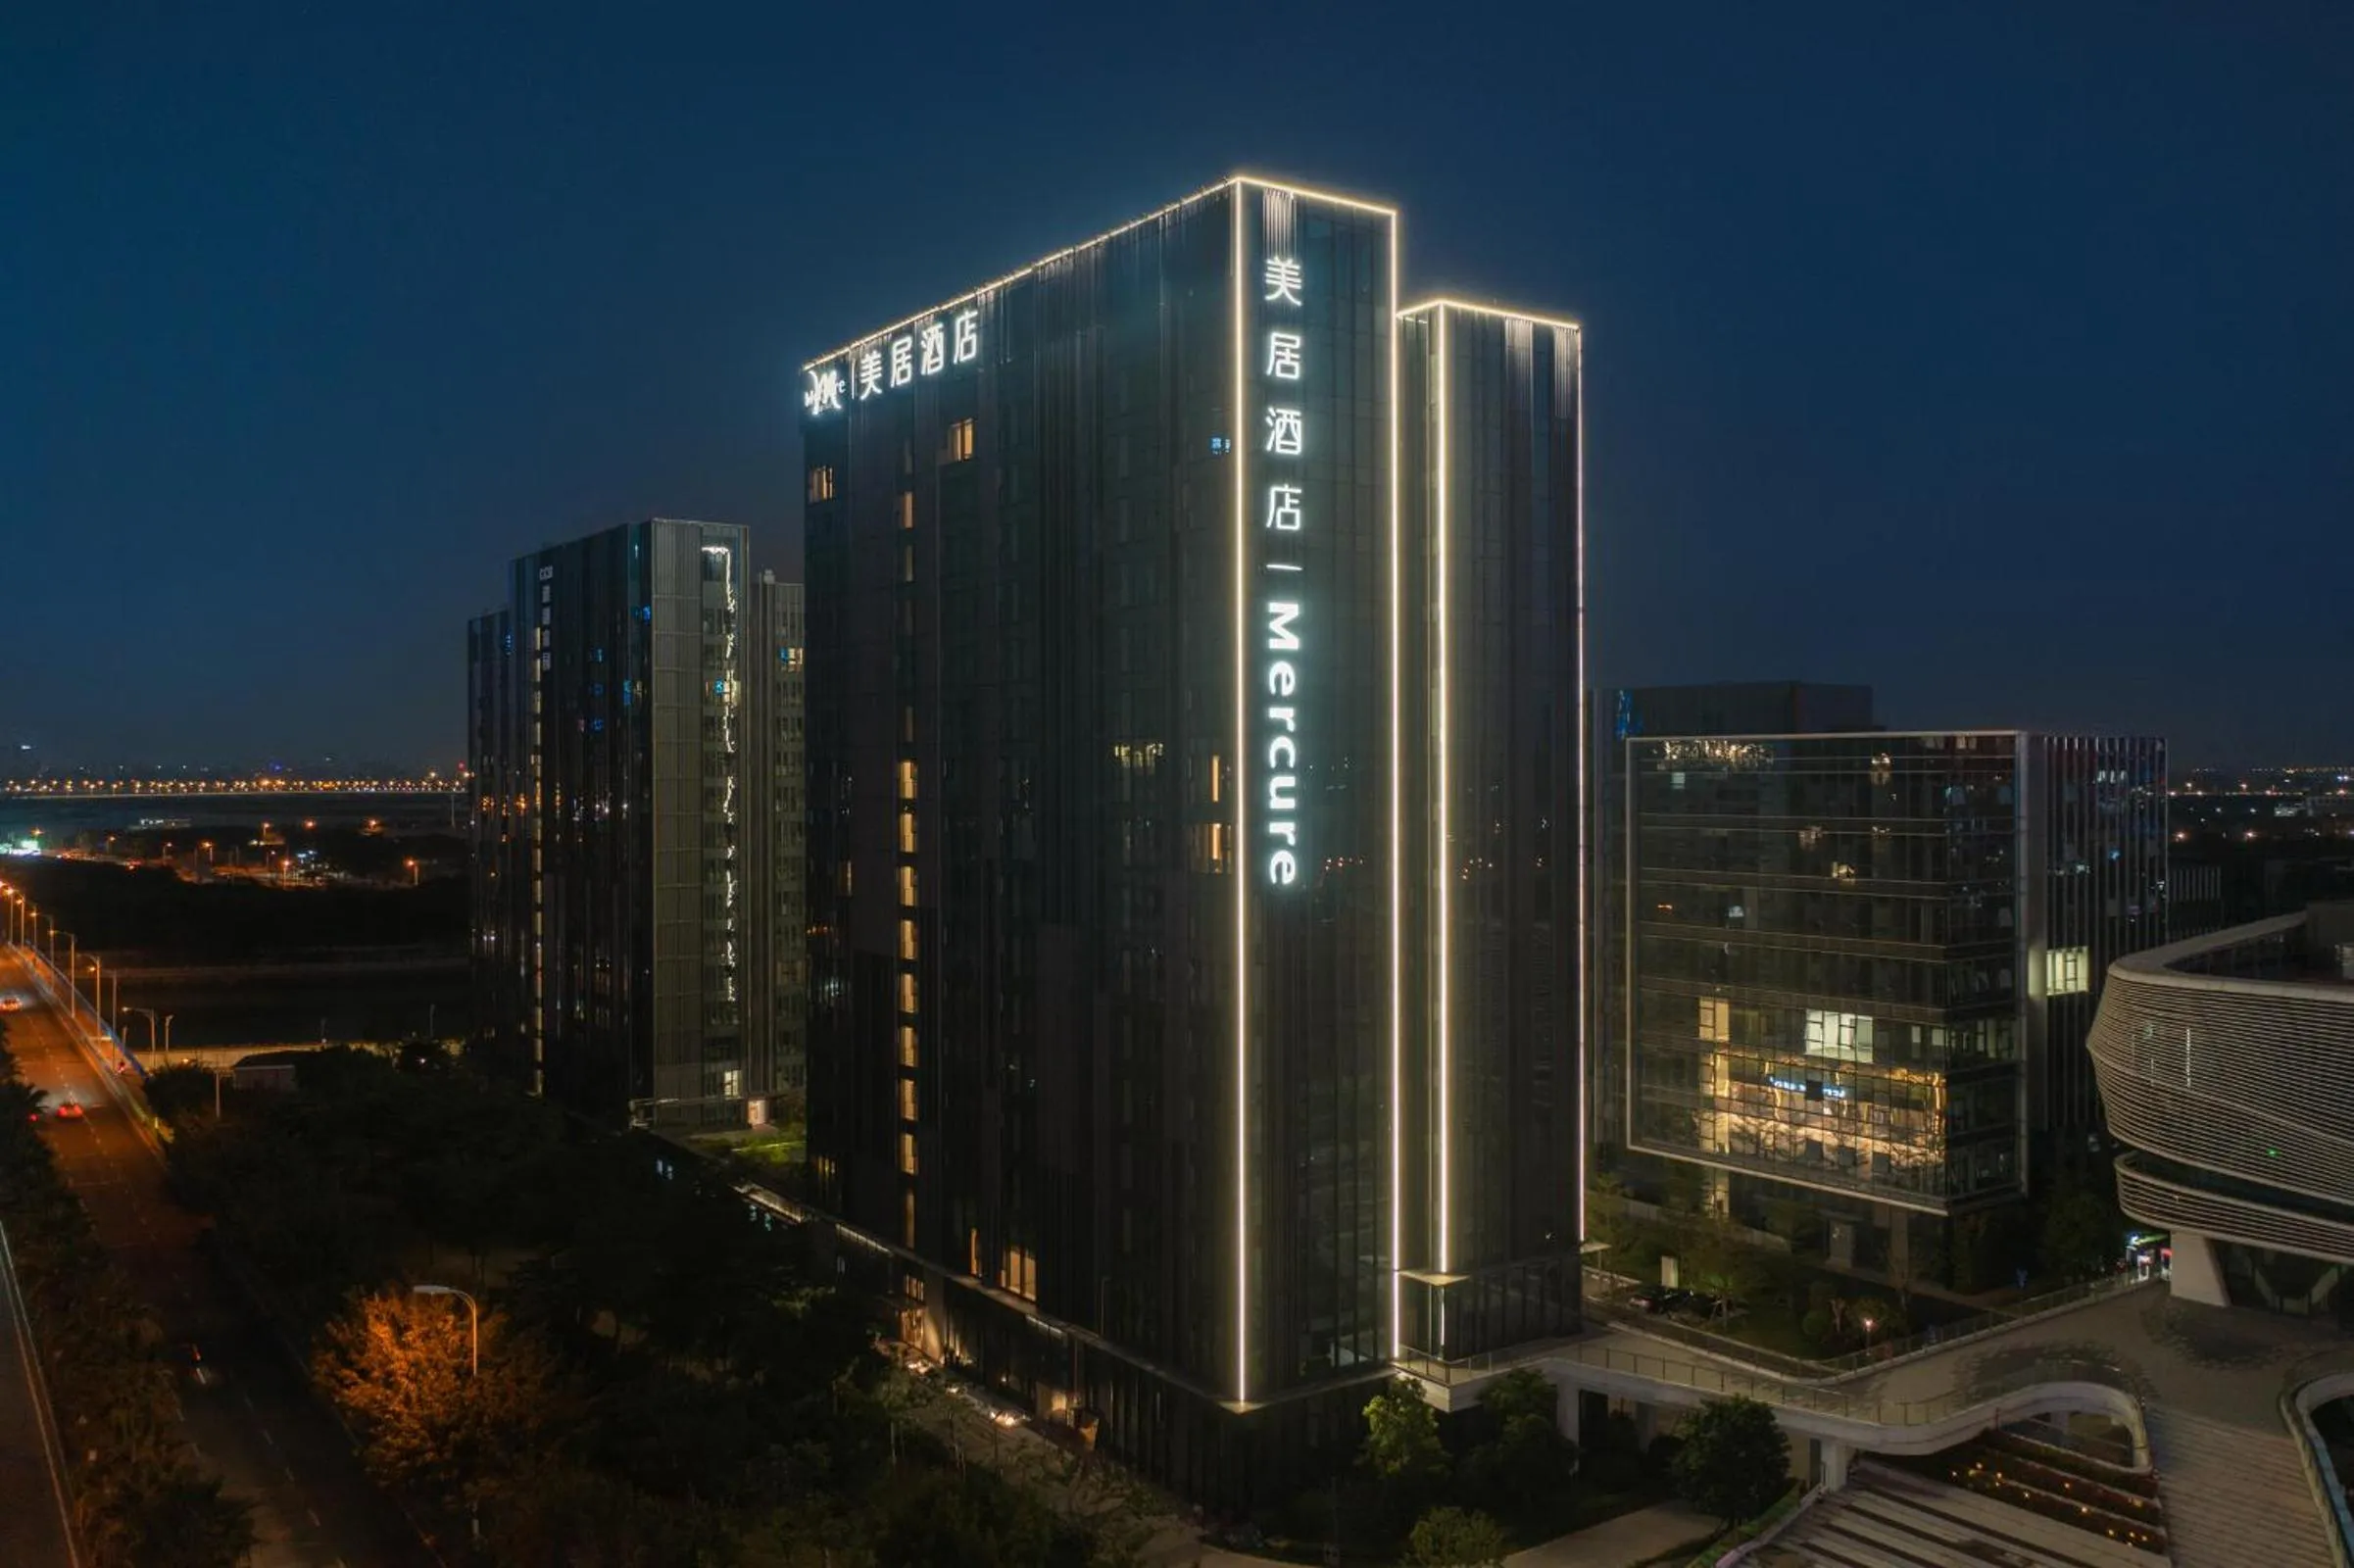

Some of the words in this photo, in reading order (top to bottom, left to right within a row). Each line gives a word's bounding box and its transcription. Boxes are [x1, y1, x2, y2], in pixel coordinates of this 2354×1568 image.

[858, 311, 979, 401] 美居酒店
[1264, 256, 1302, 531] 美居酒店
[1268, 601, 1300, 885] Mercure
